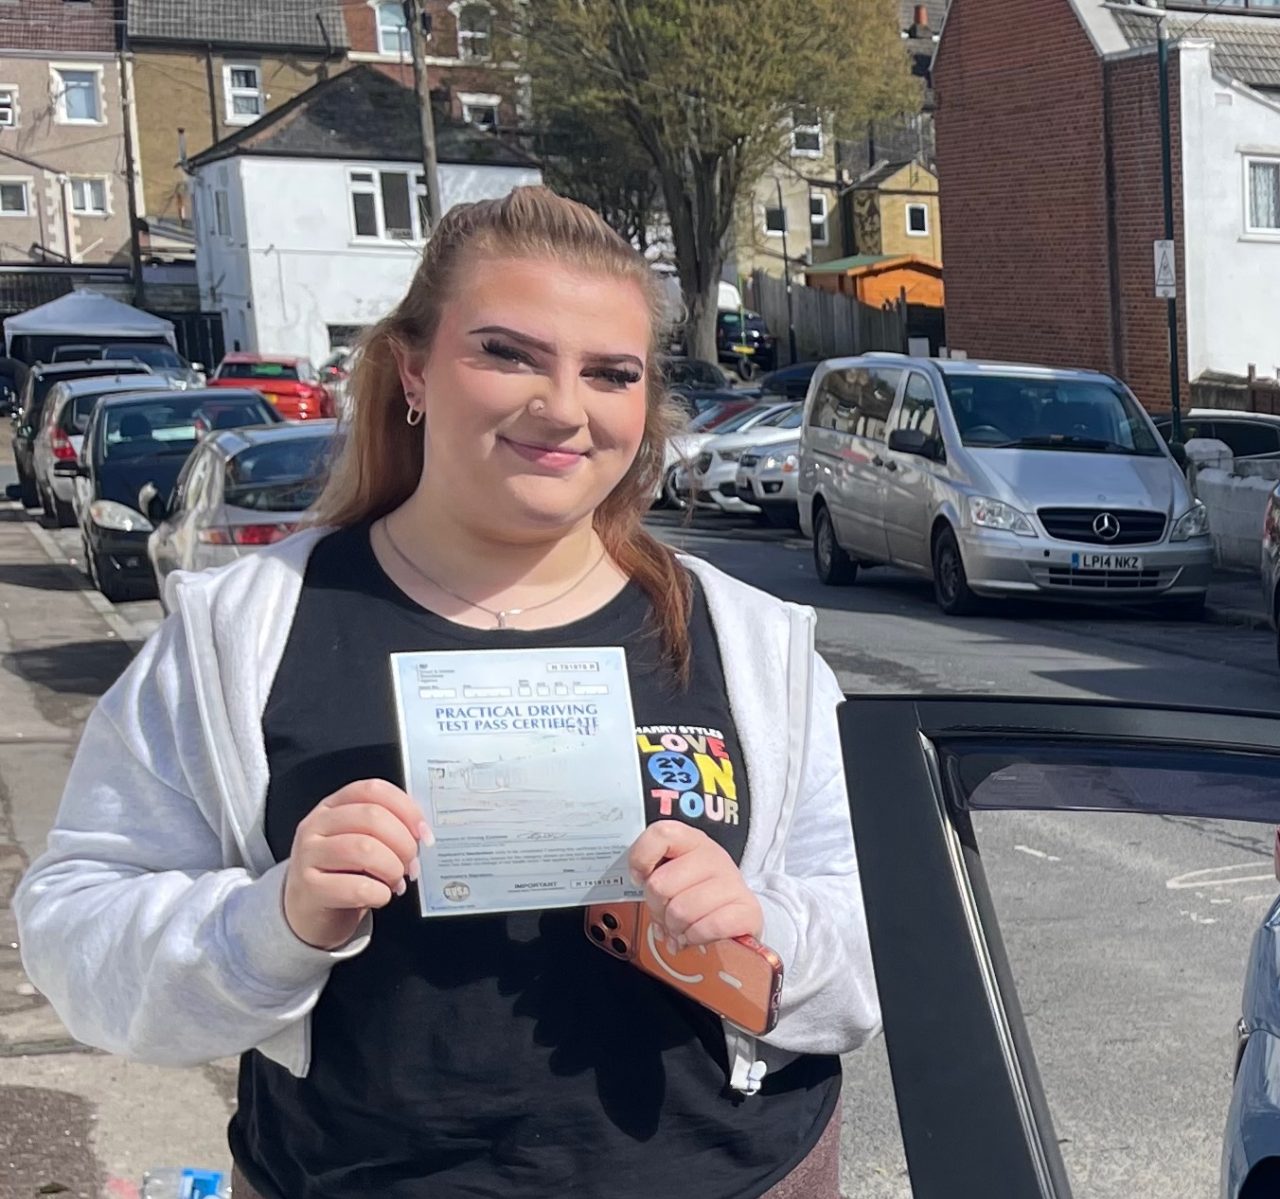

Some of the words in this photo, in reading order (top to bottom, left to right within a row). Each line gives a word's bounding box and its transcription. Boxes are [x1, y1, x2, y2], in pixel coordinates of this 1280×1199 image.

[1083, 555, 1111, 569] LP14
[1114, 556, 1139, 569] NKZ
[435, 705, 523, 719] PRACTICAL
[527, 703, 599, 717] DRIVING
[437, 719, 470, 732] TEST
[474, 718, 509, 731] PASS
[636, 733, 730, 761] LOVE
[650, 788, 739, 826] TOUR
